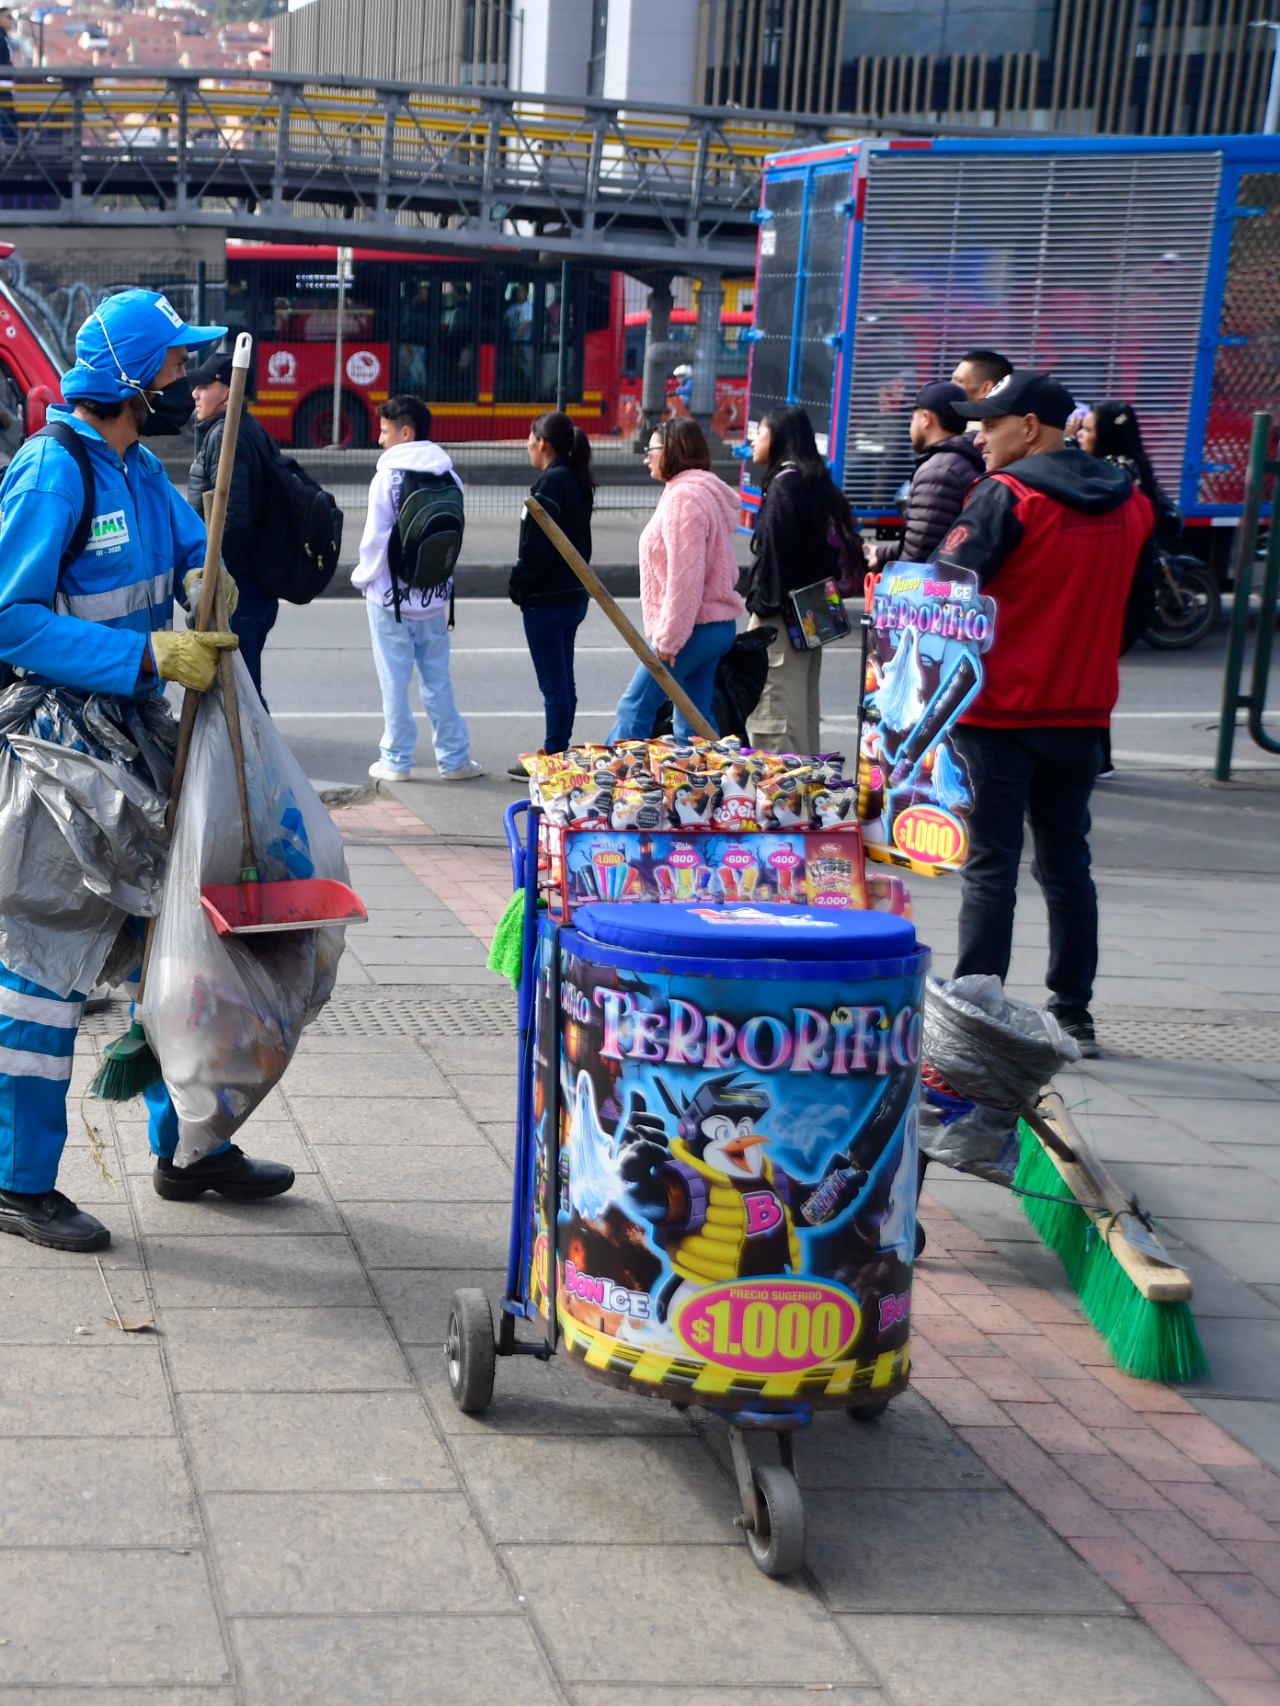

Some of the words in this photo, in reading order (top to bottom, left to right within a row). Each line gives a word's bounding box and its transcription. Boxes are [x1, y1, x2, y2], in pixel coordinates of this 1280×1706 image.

[888, 576, 920, 596] Nuevo
[898, 816, 955, 860] $1.000
[744, 1190, 782, 1237] B
[729, 1287, 769, 1300] PRECIO
[771, 1290, 823, 1301] SUGERIDO
[691, 1300, 842, 1358] $1.000
